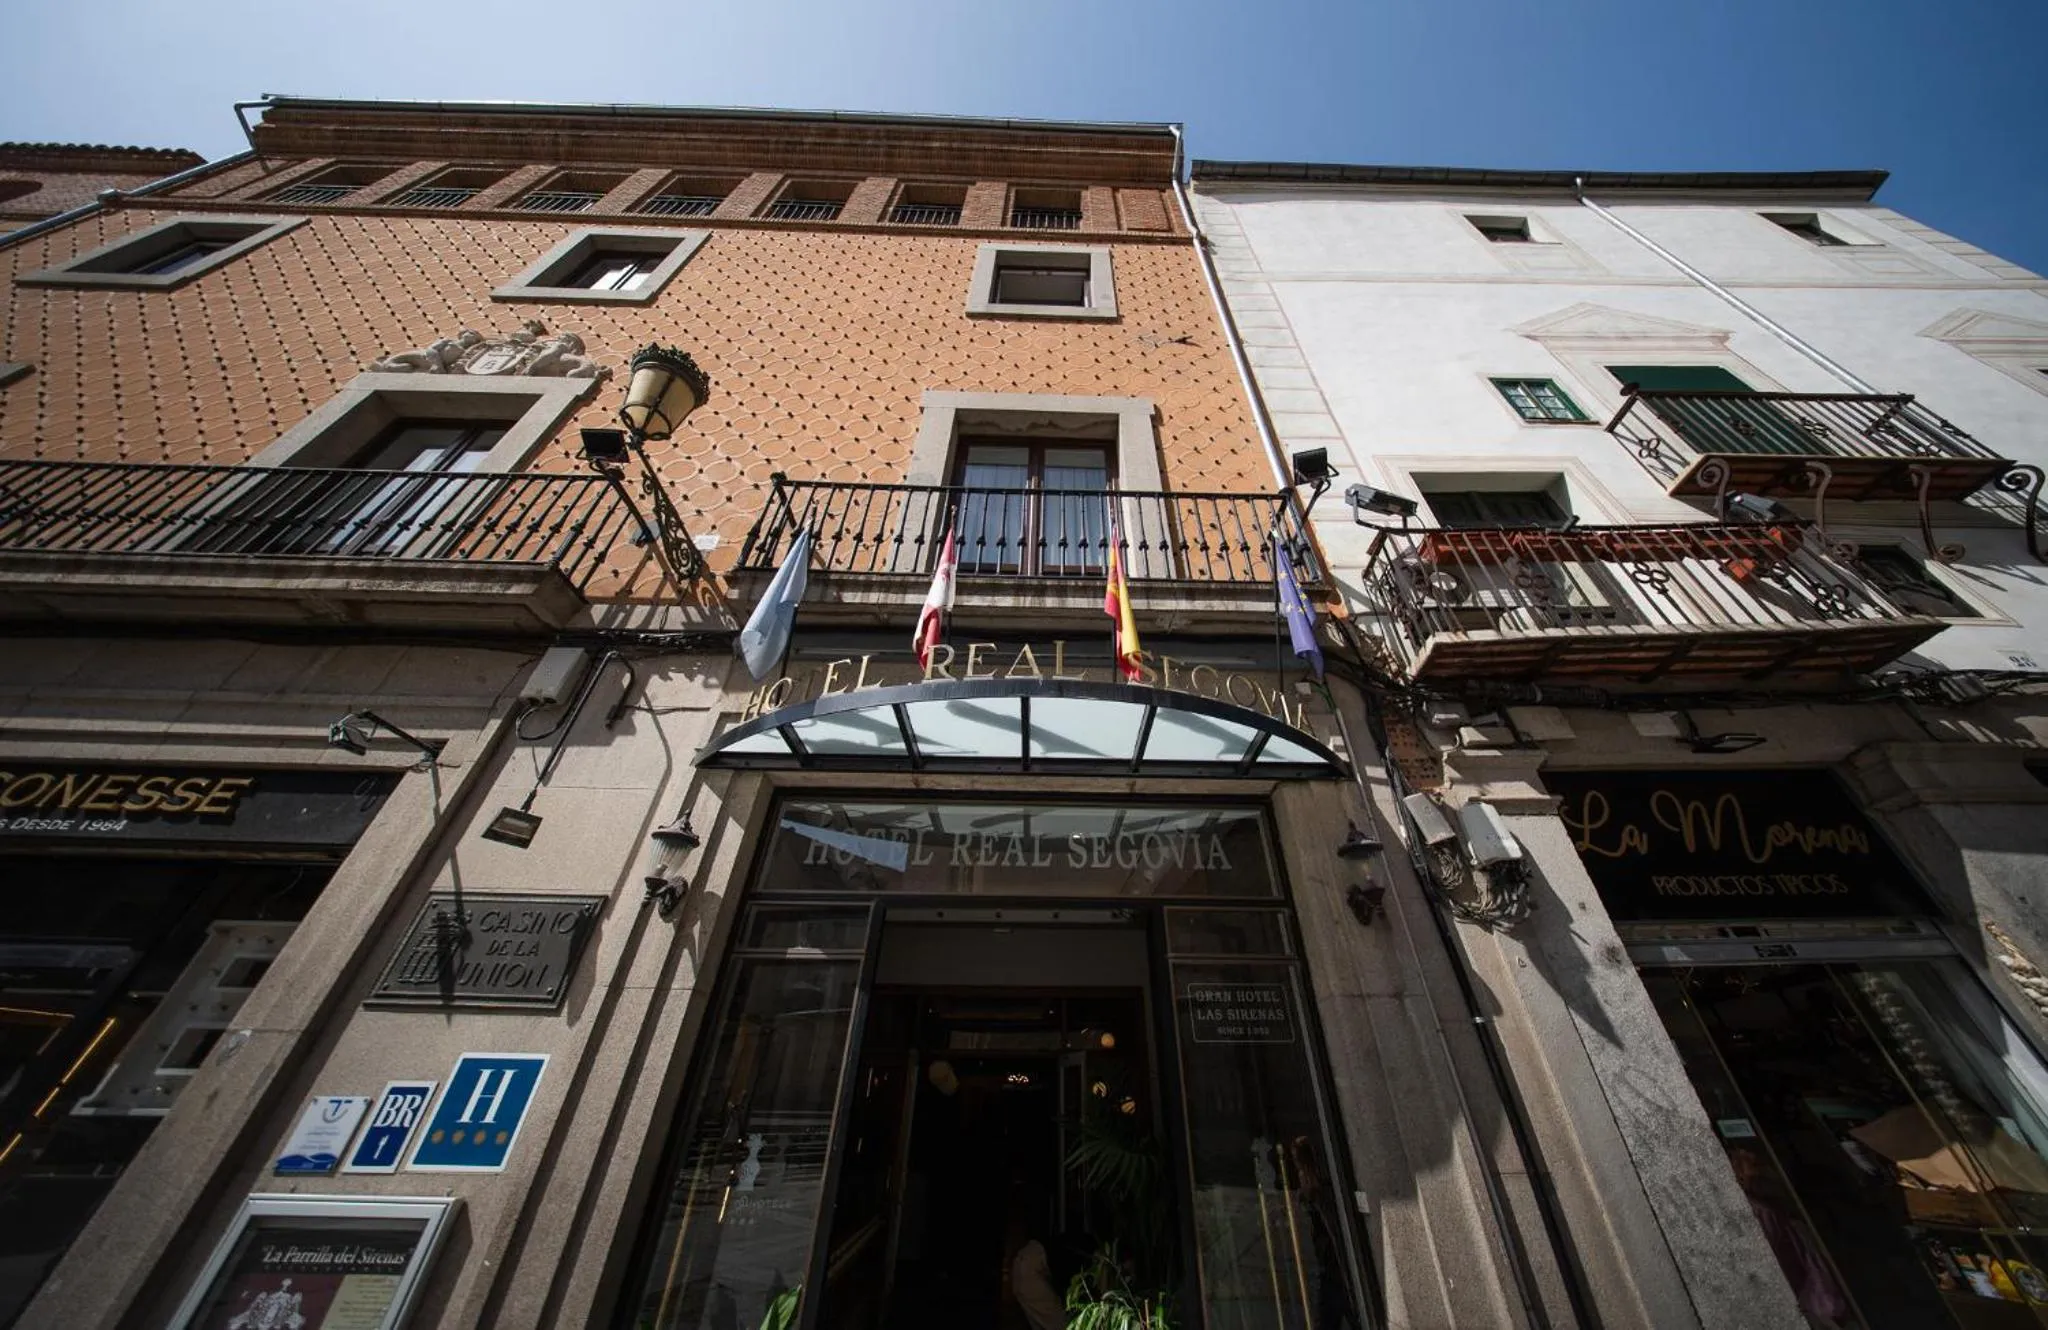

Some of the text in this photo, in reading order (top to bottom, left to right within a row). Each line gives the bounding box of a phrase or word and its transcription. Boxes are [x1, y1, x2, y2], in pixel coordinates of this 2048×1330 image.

[921, 640, 1088, 684] REAL
[0, 772, 254, 814] ONESSE
[10, 817, 76, 831] DESDE
[79, 819, 128, 832] 1984
[1559, 790, 1870, 864] La Morena
[950, 829, 1053, 868] REAL
[1067, 830, 1233, 871] SEGOVIA
[1651, 875, 1775, 897] PRODUCTOS
[480, 911, 579, 935] CASINO
[485, 939, 541, 957] DE LA
[1236, 990, 1280, 1002] HOTEL
[1197, 1008, 1286, 1021] LAS SIRENAS
[456, 1068, 520, 1124] H
[374, 1094, 423, 1128] BR
